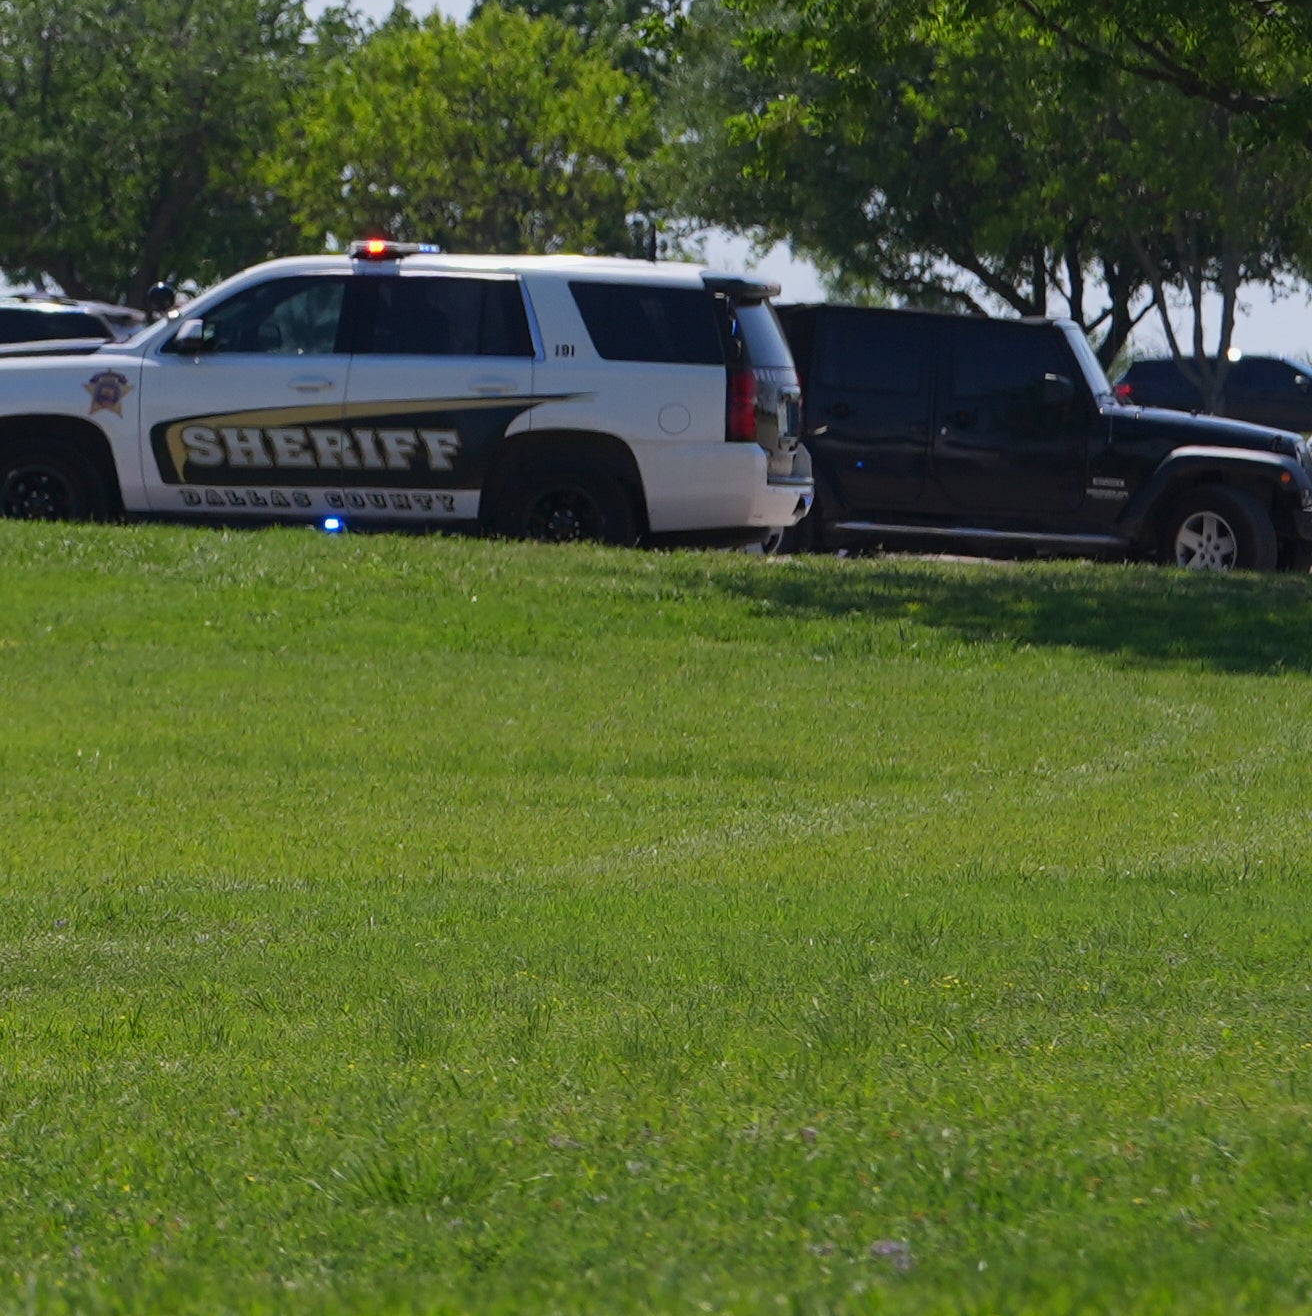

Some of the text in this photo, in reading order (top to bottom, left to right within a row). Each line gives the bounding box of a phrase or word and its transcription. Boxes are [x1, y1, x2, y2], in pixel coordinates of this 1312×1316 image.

[554, 344, 576, 358] 191
[181, 426, 461, 471] SHERIFF
[179, 488, 456, 513] DALLAS COUNTY
